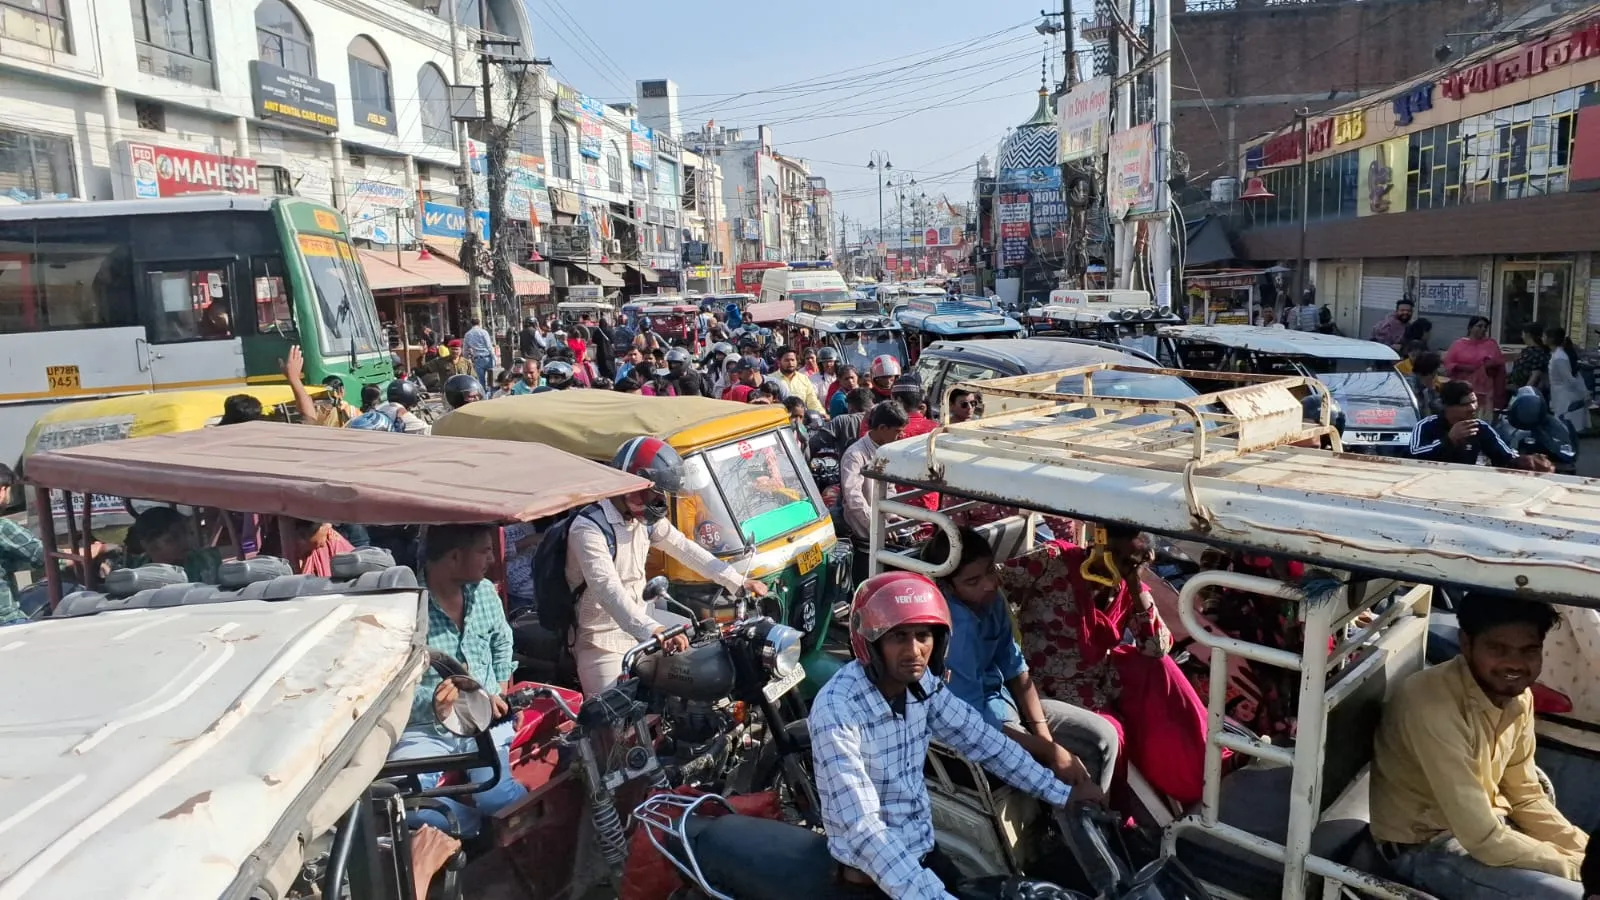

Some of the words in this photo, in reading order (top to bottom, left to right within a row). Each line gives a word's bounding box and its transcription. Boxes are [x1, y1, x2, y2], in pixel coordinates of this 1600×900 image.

[1334, 108, 1363, 145] LAB
[173, 156, 258, 190] MAHESH
[700, 532, 721, 545] 636
[894, 595, 911, 604] VERY
